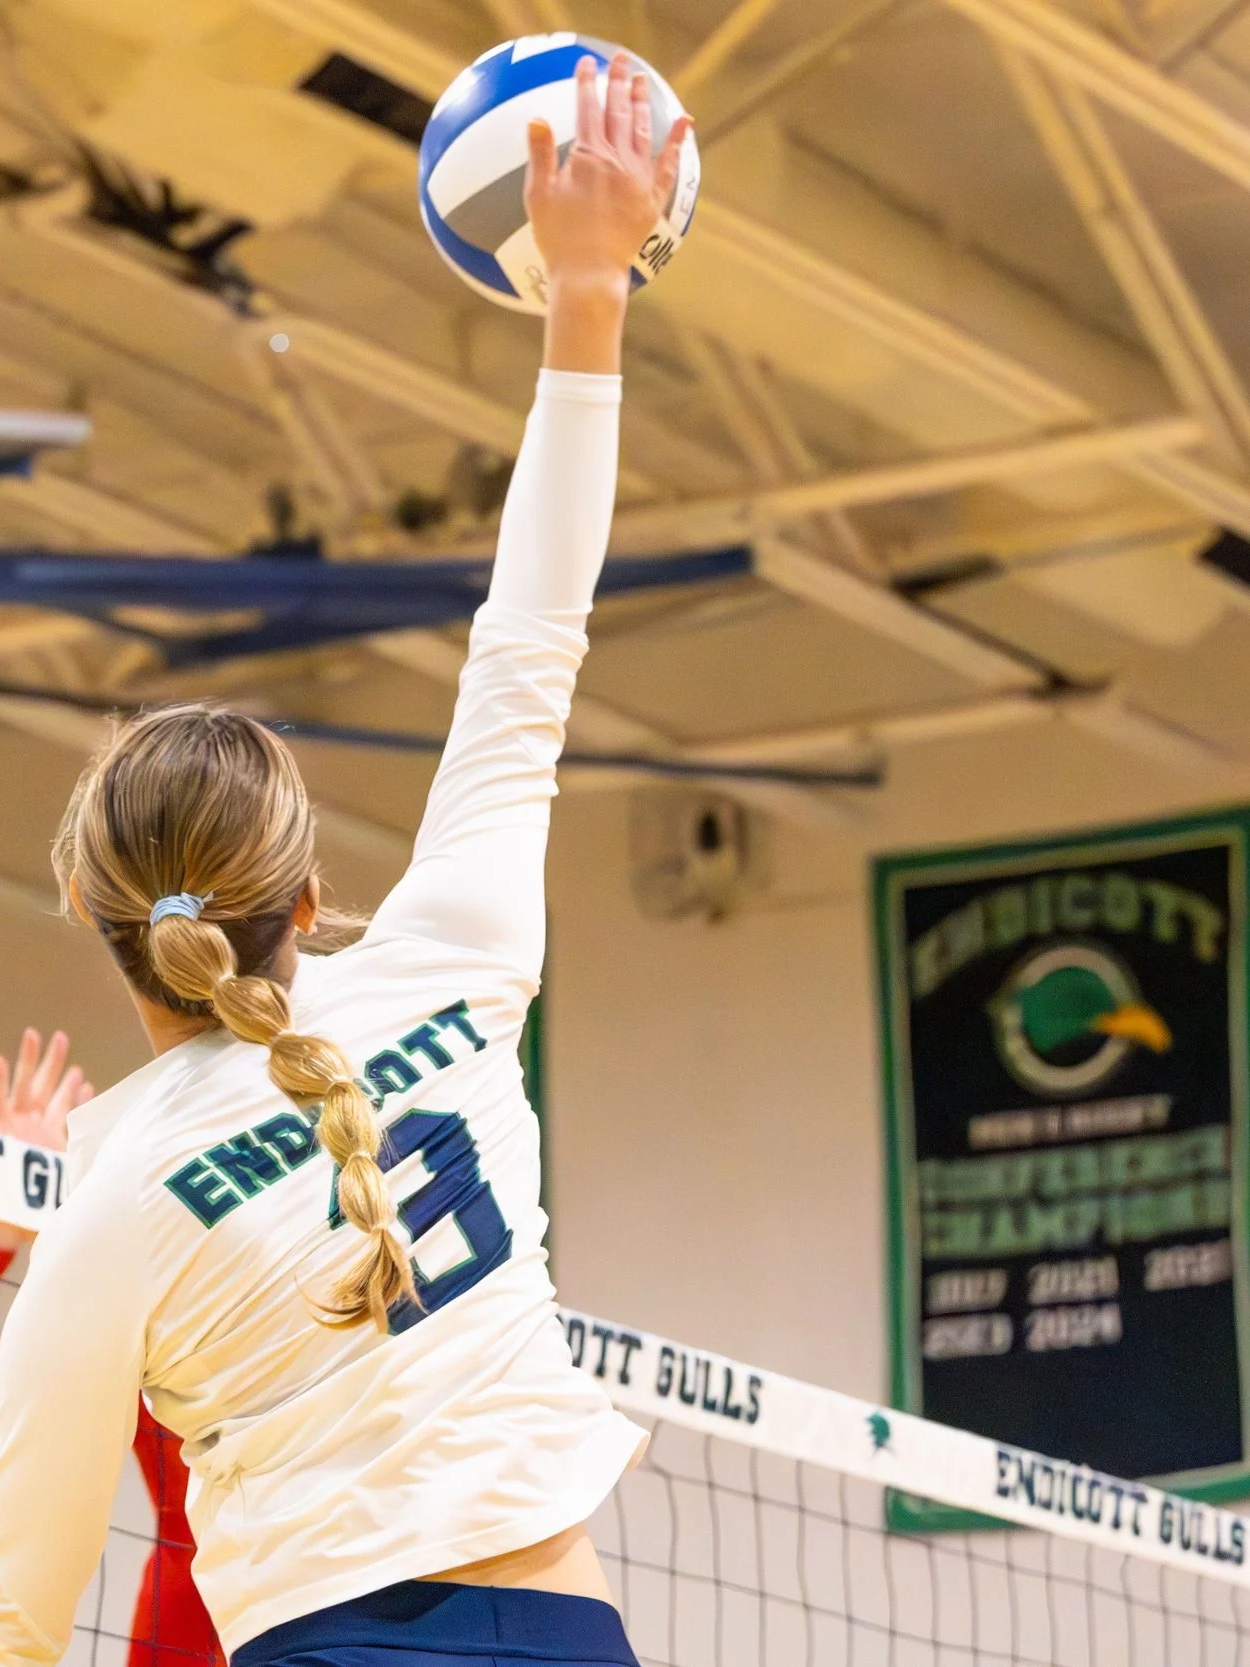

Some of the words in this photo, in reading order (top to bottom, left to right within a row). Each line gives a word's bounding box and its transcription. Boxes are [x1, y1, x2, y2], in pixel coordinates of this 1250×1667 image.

[163, 998, 488, 1229] ENDOTT
[656, 1345, 764, 1425] GULLS
[996, 1449, 1148, 1537] ENDICOTT
[1159, 1500, 1245, 1566] GULLS
